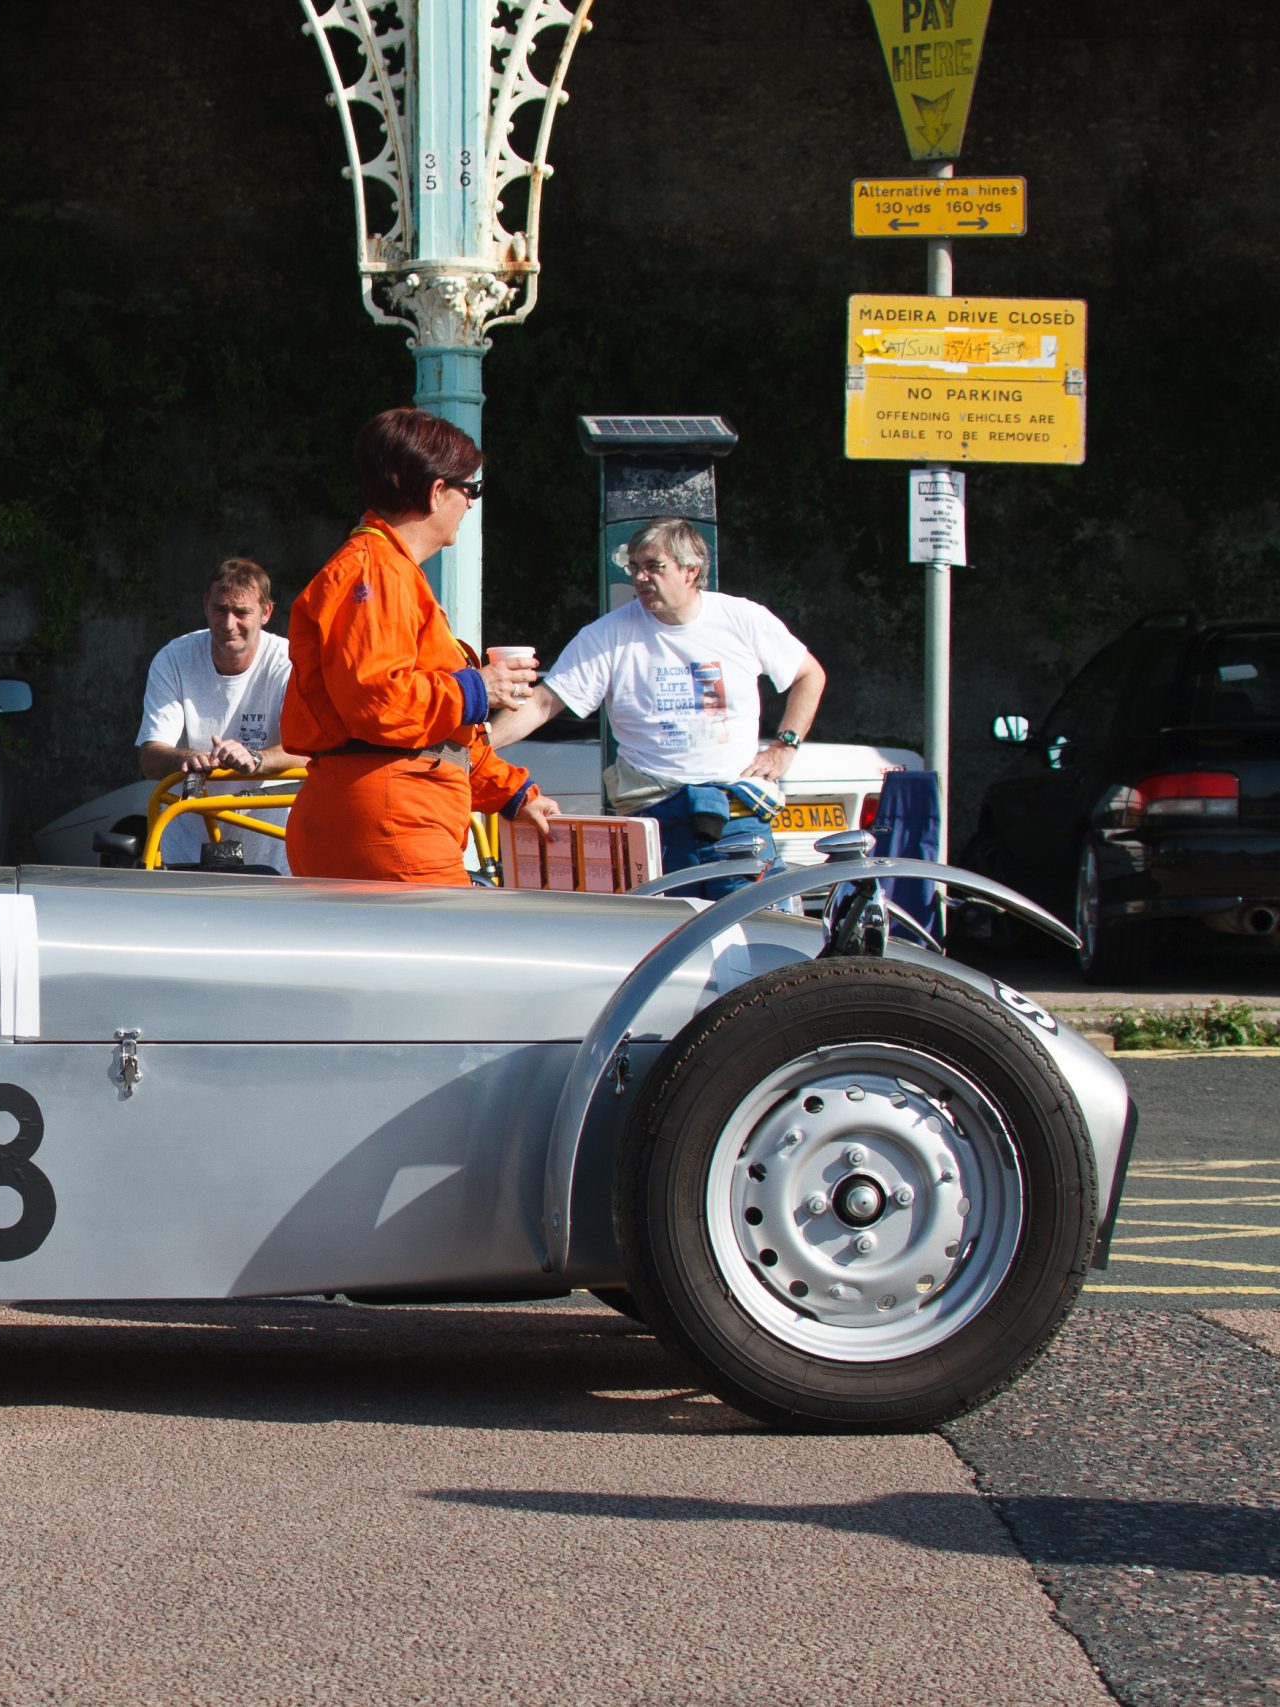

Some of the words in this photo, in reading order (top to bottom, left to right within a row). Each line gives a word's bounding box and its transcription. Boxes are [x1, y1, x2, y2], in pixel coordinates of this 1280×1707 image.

[903, 0, 955, 33] PAY
[891, 38, 974, 82] HERE
[858, 186, 941, 197] Alternative
[875, 202, 903, 214] 130
[906, 203, 931, 216] yds
[946, 201, 973, 213] 160
[976, 200, 1002, 214] yds
[860, 308, 936, 322] MADEIRA
[948, 311, 998, 324] DRIVE
[1008, 311, 1075, 325] CLOSED
[907, 387, 932, 400] NO
[947, 388, 1023, 402] PARKING
[876, 411, 950, 422] OFFENDING
[960, 412, 1021, 423] VEHICLES
[1030, 414, 1055, 424] ARE
[881, 430, 926, 440] LIABLE
[936, 431, 953, 440] TO
[963, 431, 978, 441] BE
[989, 431, 1050, 442] REMOVED
[656, 666, 690, 676] RACING
[659, 682, 688, 692] LIFE
[656, 697, 695, 711] BEFORE
[809, 806, 844, 827] MAB
